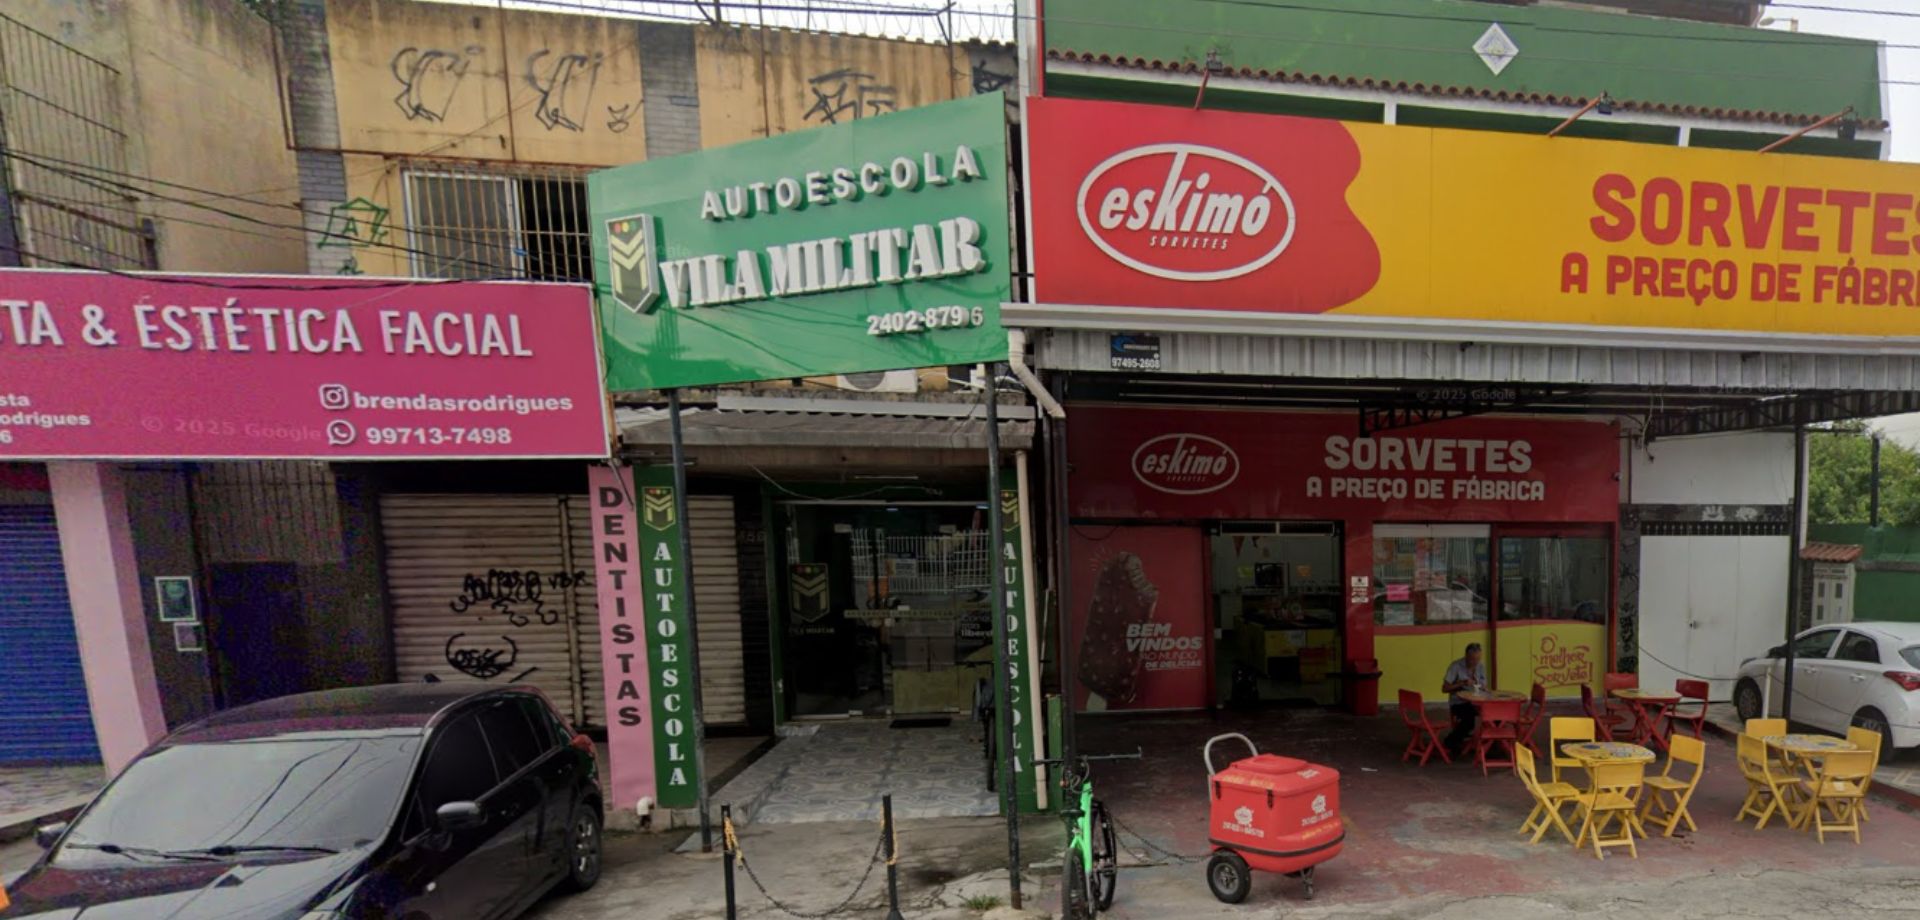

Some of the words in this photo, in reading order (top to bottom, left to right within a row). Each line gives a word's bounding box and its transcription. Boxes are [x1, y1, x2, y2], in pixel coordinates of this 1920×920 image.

[701, 145, 981, 220] AUTOESCOLA
[1099, 151, 1272, 236] eskimó
[1590, 173, 1920, 256] SORVETE
[659, 250, 767, 309] VILA
[767, 217, 986, 297] MILITAR
[1150, 235, 1228, 249] SORVETES
[1561, 252, 1588, 293] A
[1607, 255, 1738, 306] PREÇO
[1751, 262, 1802, 302] DE
[0, 300, 63, 346] TA
[82, 304, 117, 346] &
[379, 309, 534, 357] FACIAL
[354, 391, 573, 414] brendasrodrigues
[366, 427, 512, 445] 99713-7498
[1142, 437, 1228, 475] eskimó
[1324, 435, 1532, 473] SORVETES
[1306, 476, 1322, 497] A
[1331, 477, 1407, 502] PREÇO
[1415, 479, 1445, 499] DE
[1453, 475, 1545, 501] FÁBRICA
[599, 486, 642, 727] DENTISTAS
[1126, 623, 1171, 638] BEM
[1126, 636, 1203, 652] VINDOS
[654, 542, 688, 786] AUTOESCOLA
